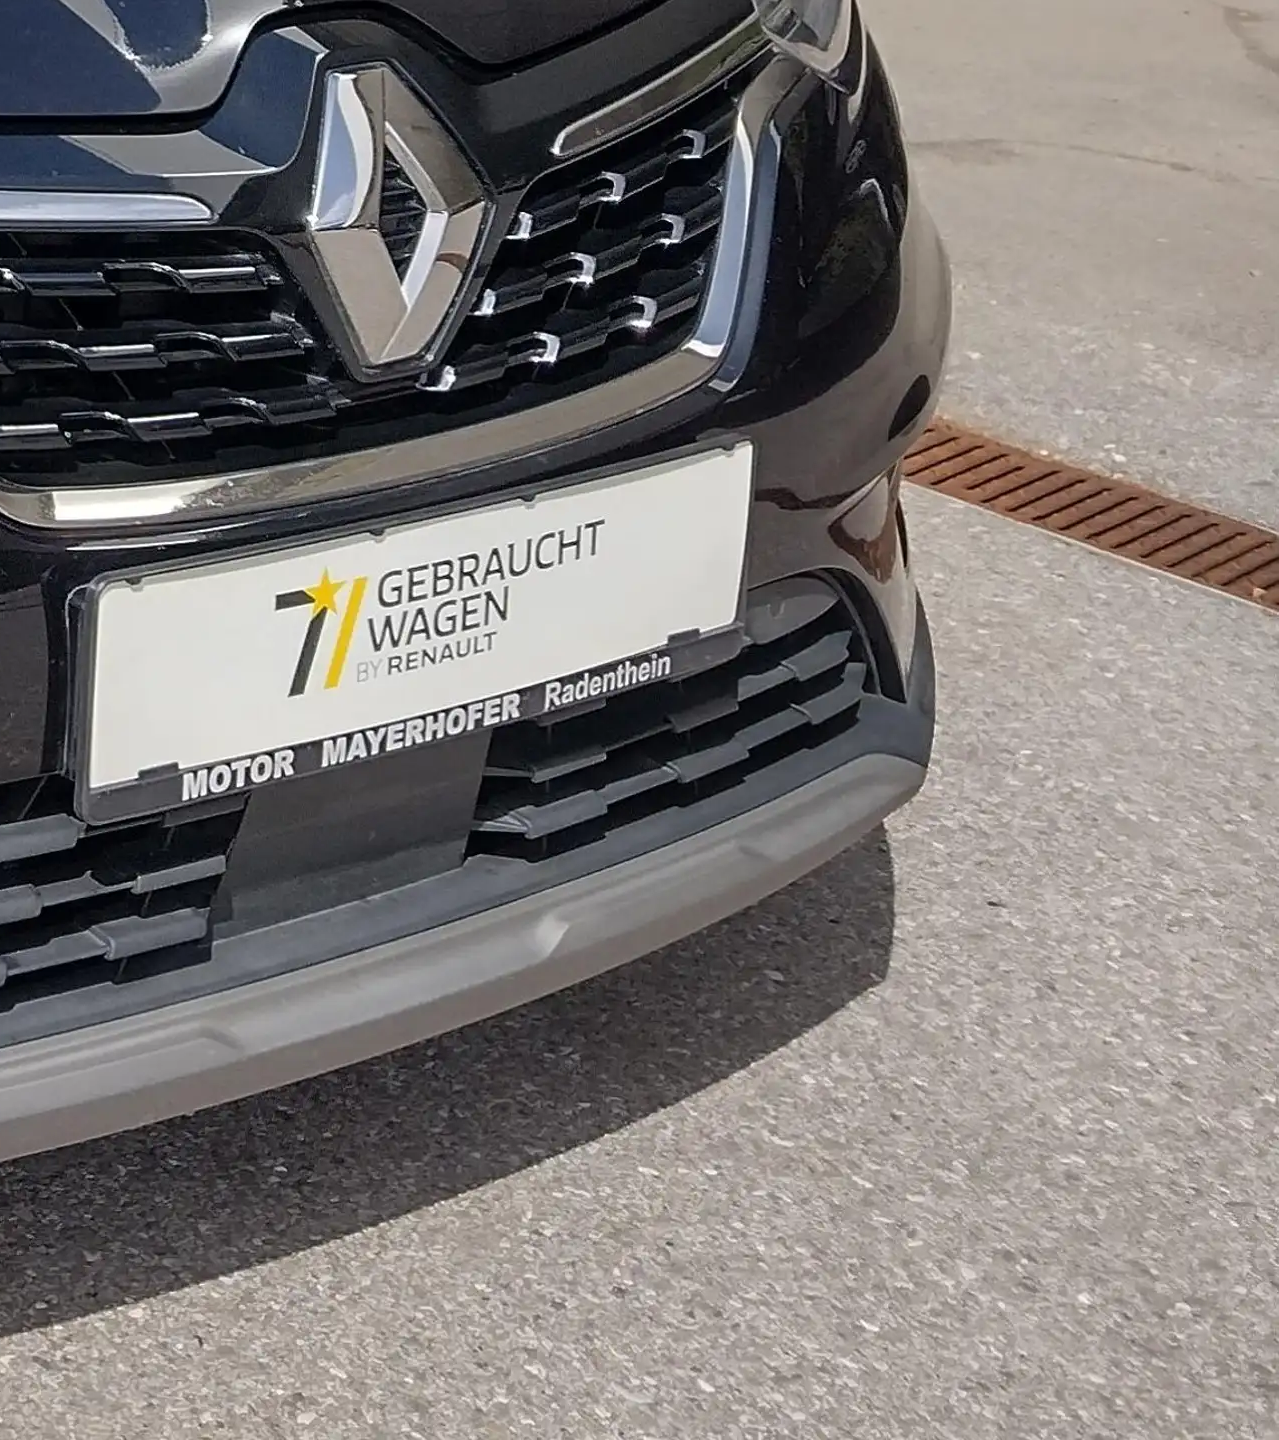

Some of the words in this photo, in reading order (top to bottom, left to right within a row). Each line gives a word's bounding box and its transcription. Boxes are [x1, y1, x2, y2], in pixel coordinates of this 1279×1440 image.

[377, 518, 606, 609] GEBRAUCHT
[357, 659, 383, 684] BY
[387, 631, 498, 676] RENAULT
[367, 586, 510, 652] WAGEN
[180, 748, 296, 802] MOTOR
[321, 692, 521, 769] MAYERHOFER
[543, 653, 673, 713] Radenthein
